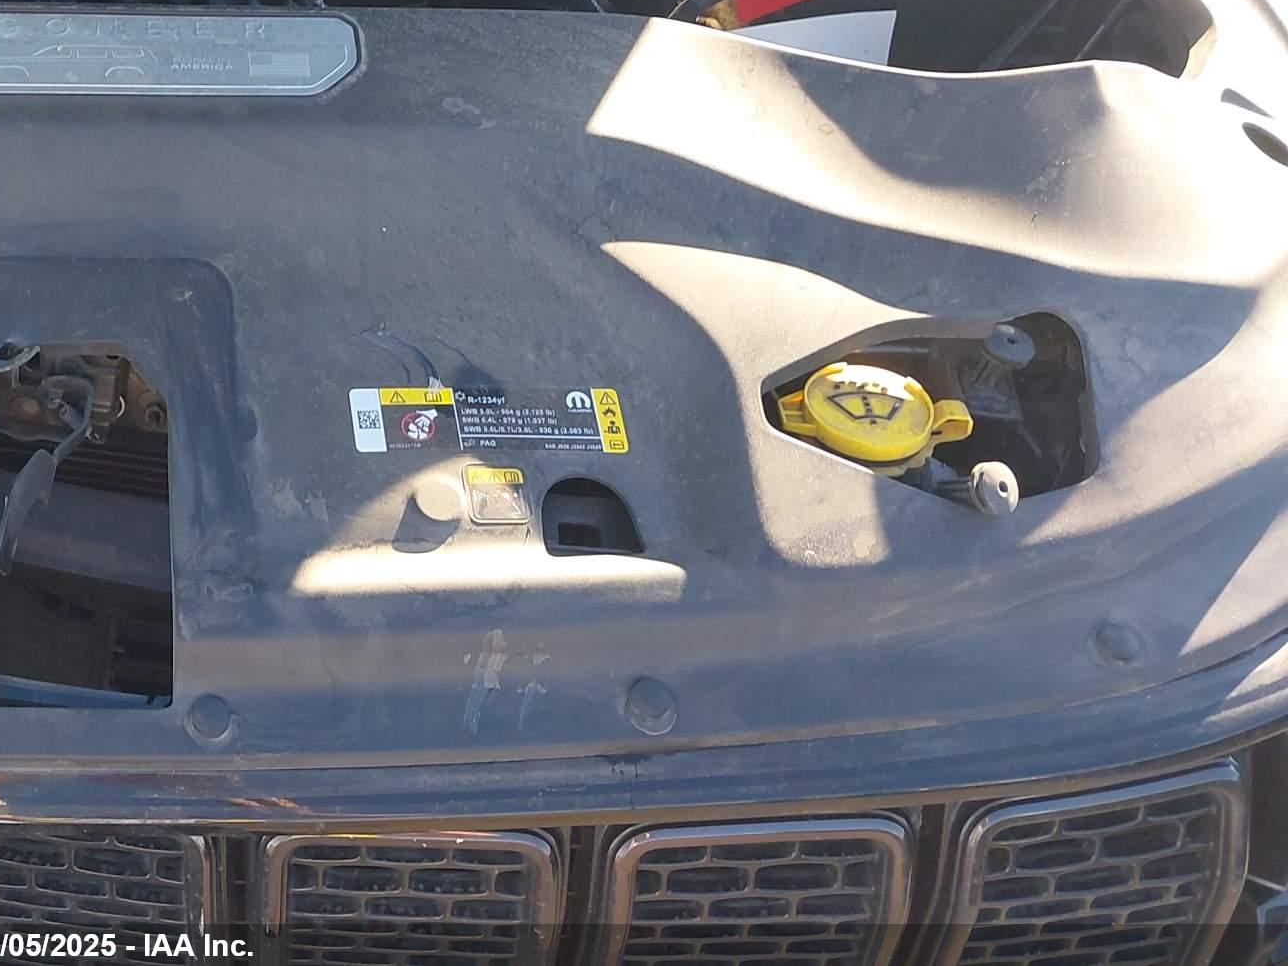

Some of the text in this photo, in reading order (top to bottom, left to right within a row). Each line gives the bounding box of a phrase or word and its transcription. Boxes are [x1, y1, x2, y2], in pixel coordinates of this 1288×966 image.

[170, 62, 233, 71] AMERICA
[467, 396, 505, 405] R-1234yf
[479, 439, 497, 447] PAG
